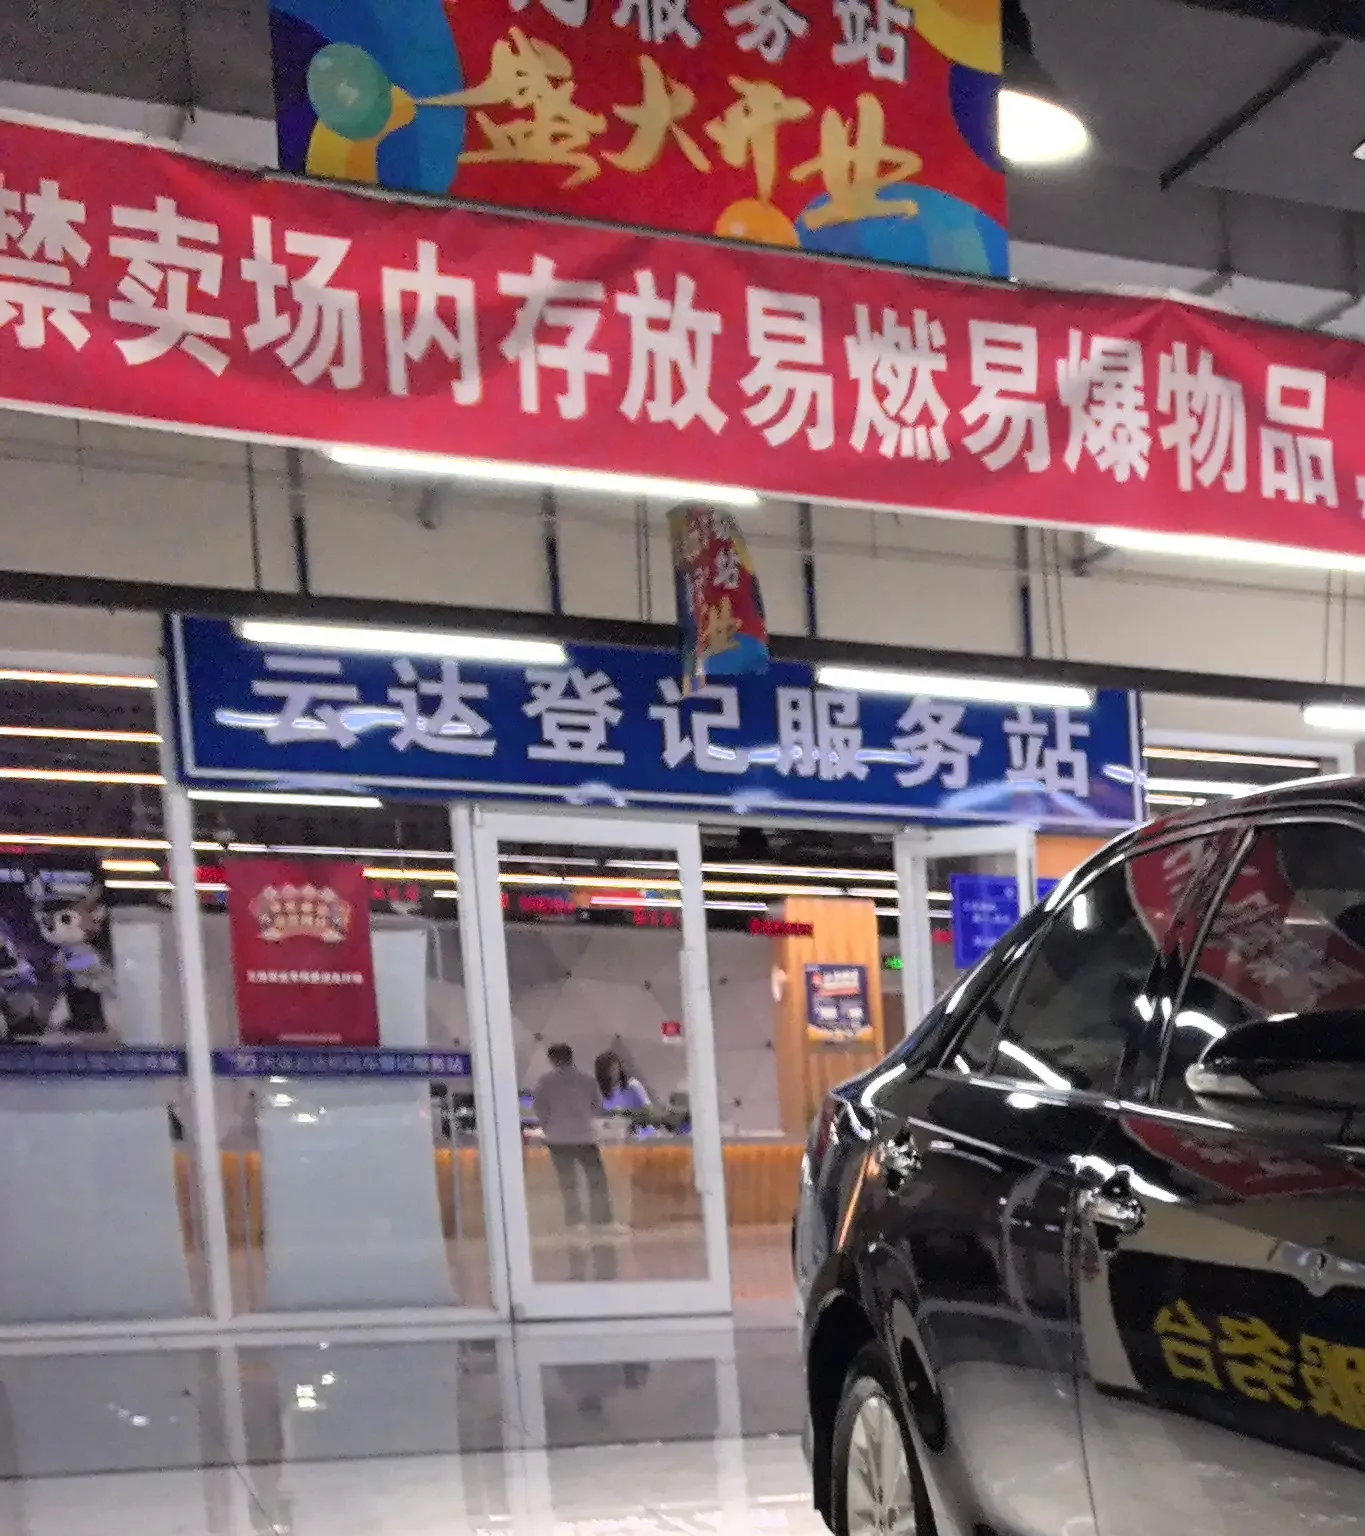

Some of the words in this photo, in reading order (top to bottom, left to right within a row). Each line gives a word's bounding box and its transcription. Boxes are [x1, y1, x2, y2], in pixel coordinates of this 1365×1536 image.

[425, 26, 923, 231] 盛大开业
[250, 653, 1092, 799] 云达登记服务站
